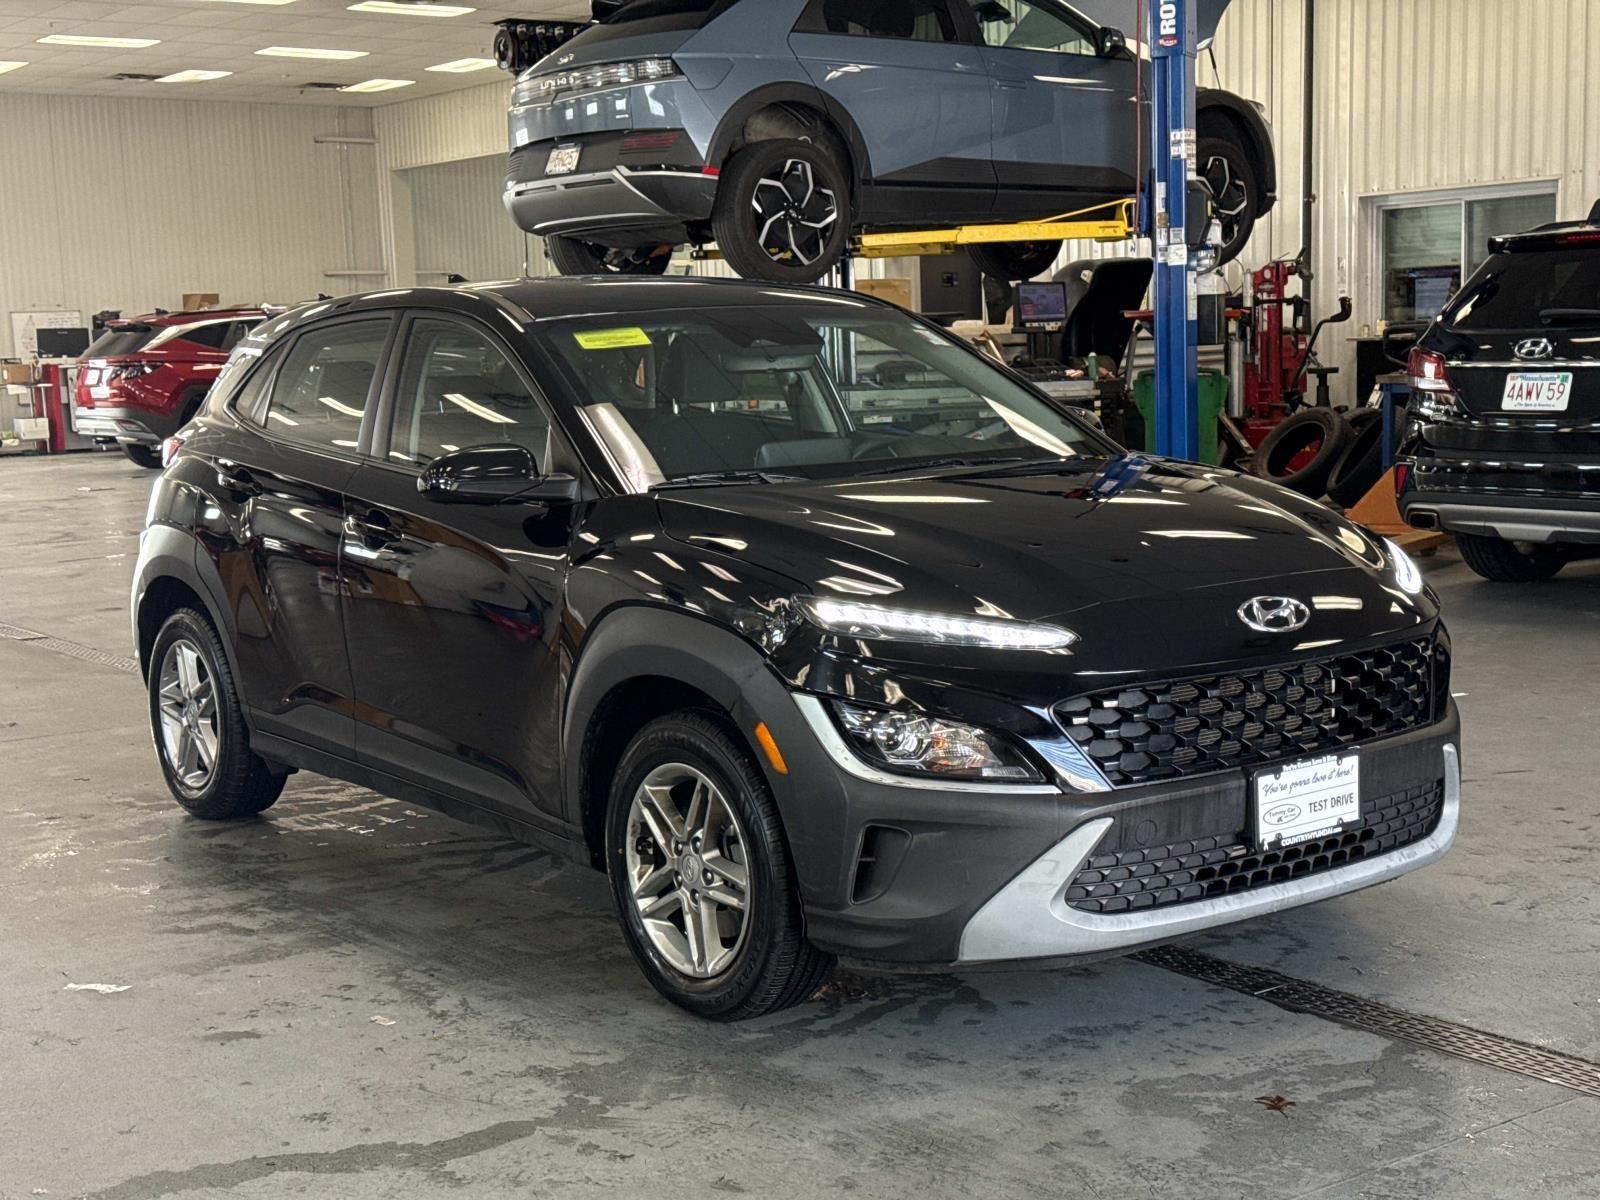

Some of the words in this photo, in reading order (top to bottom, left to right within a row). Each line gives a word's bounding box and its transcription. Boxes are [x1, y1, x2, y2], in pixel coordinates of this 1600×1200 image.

[1507, 383, 1544, 401] 4AWV
[1546, 382, 1566, 401] 59
[1312, 771, 1327, 784] love
[1309, 798, 1328, 814] TEST
[1330, 793, 1354, 808] DRIVE
